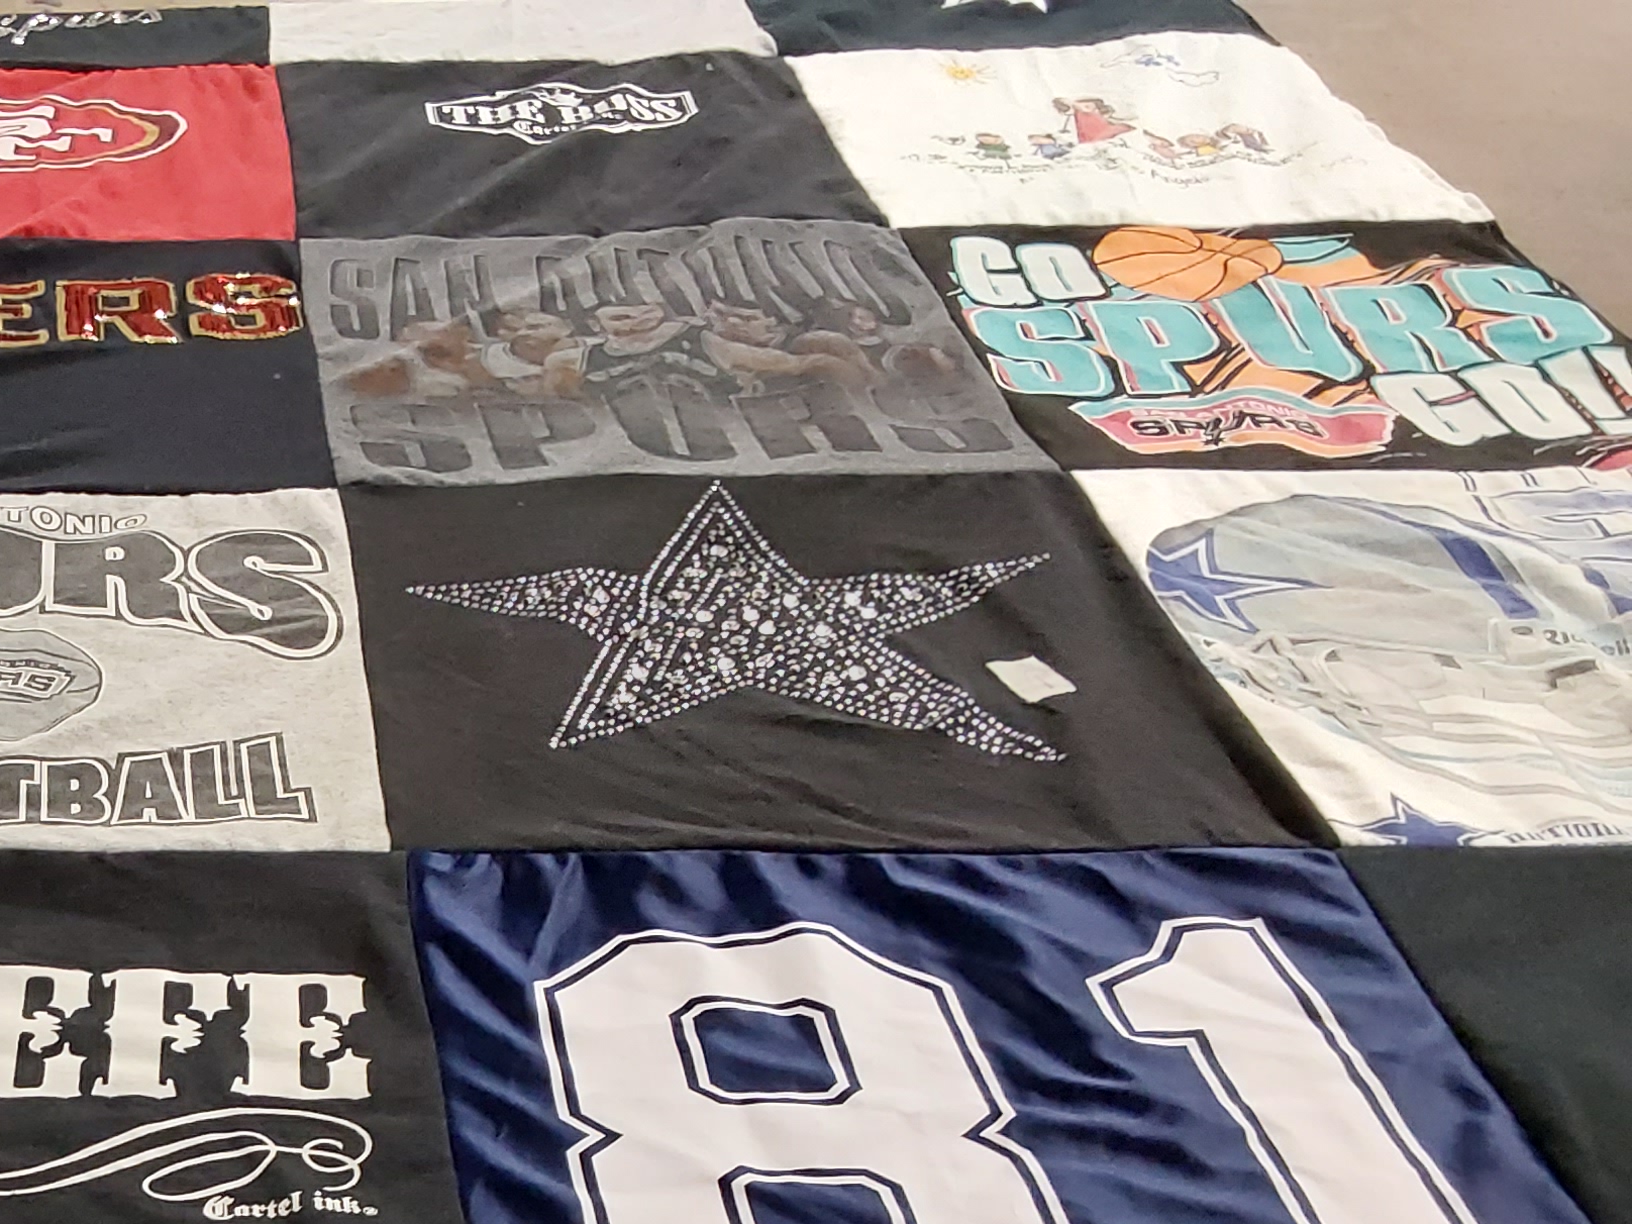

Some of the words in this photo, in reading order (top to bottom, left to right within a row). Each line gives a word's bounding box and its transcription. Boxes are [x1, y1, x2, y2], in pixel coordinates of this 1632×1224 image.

[441, 99, 545, 125] THE
[329, 253, 496, 342] SAN
[952, 235, 1107, 307] GO
[964, 264, 1614, 398] SPURS
[202, 1190, 303, 1221] Cartel
